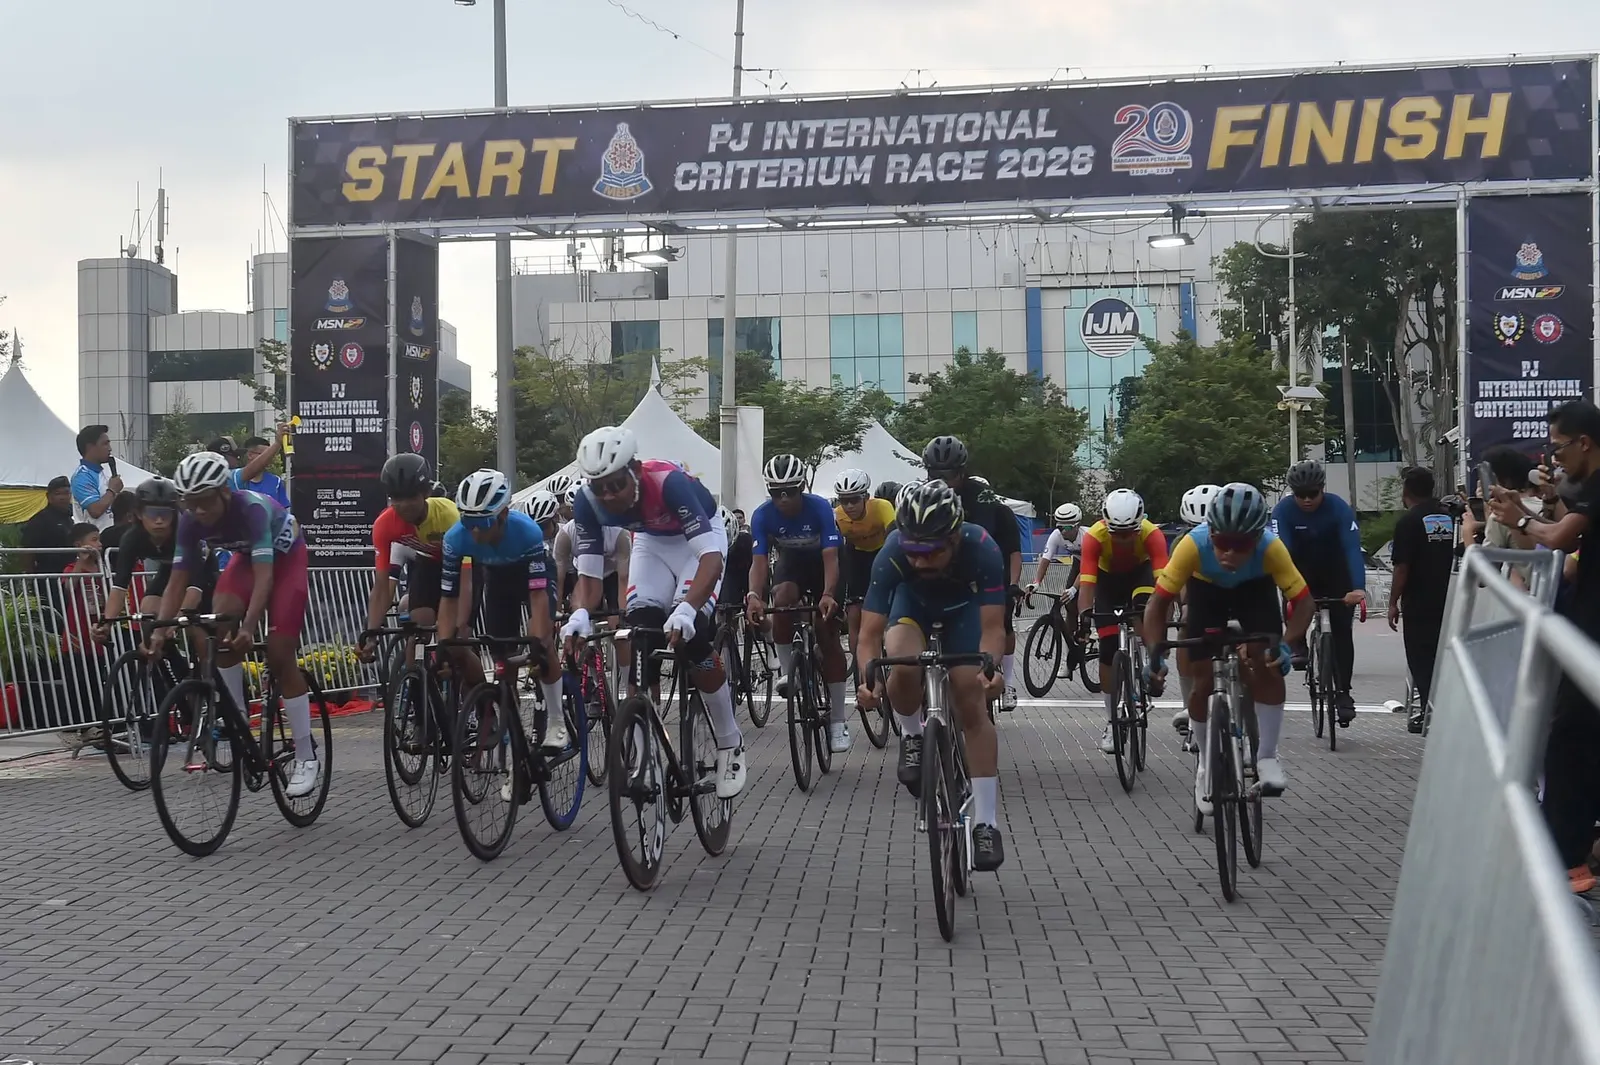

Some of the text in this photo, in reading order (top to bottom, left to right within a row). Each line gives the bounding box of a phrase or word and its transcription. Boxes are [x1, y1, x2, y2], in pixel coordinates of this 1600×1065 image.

[708, 108, 1058, 153] PJ INTERNATIONAL
[1112, 101, 1193, 157] 20
[1207, 92, 1512, 170] FINISH
[342, 137, 577, 202] START
[674, 145, 1096, 192] CRITERIUM RACE 2026
[604, 184, 642, 197] MBPJ
[1502, 288, 1537, 299] MSN
[317, 319, 344, 329] MSN
[1085, 312, 1134, 334] IJM
[405, 345, 421, 357] MSN
[1522, 361, 1540, 377] PJ
[332, 384, 346, 398] PJ
[1479, 380, 1583, 397] INTERNATIONAL
[299, 400, 379, 416] INTERNATIONAL
[1475, 401, 1548, 418] CRITERIUM
[355, 418, 383, 433] RACE
[1513, 421, 1548, 438] 2026
[325, 437, 352, 451] 2026
